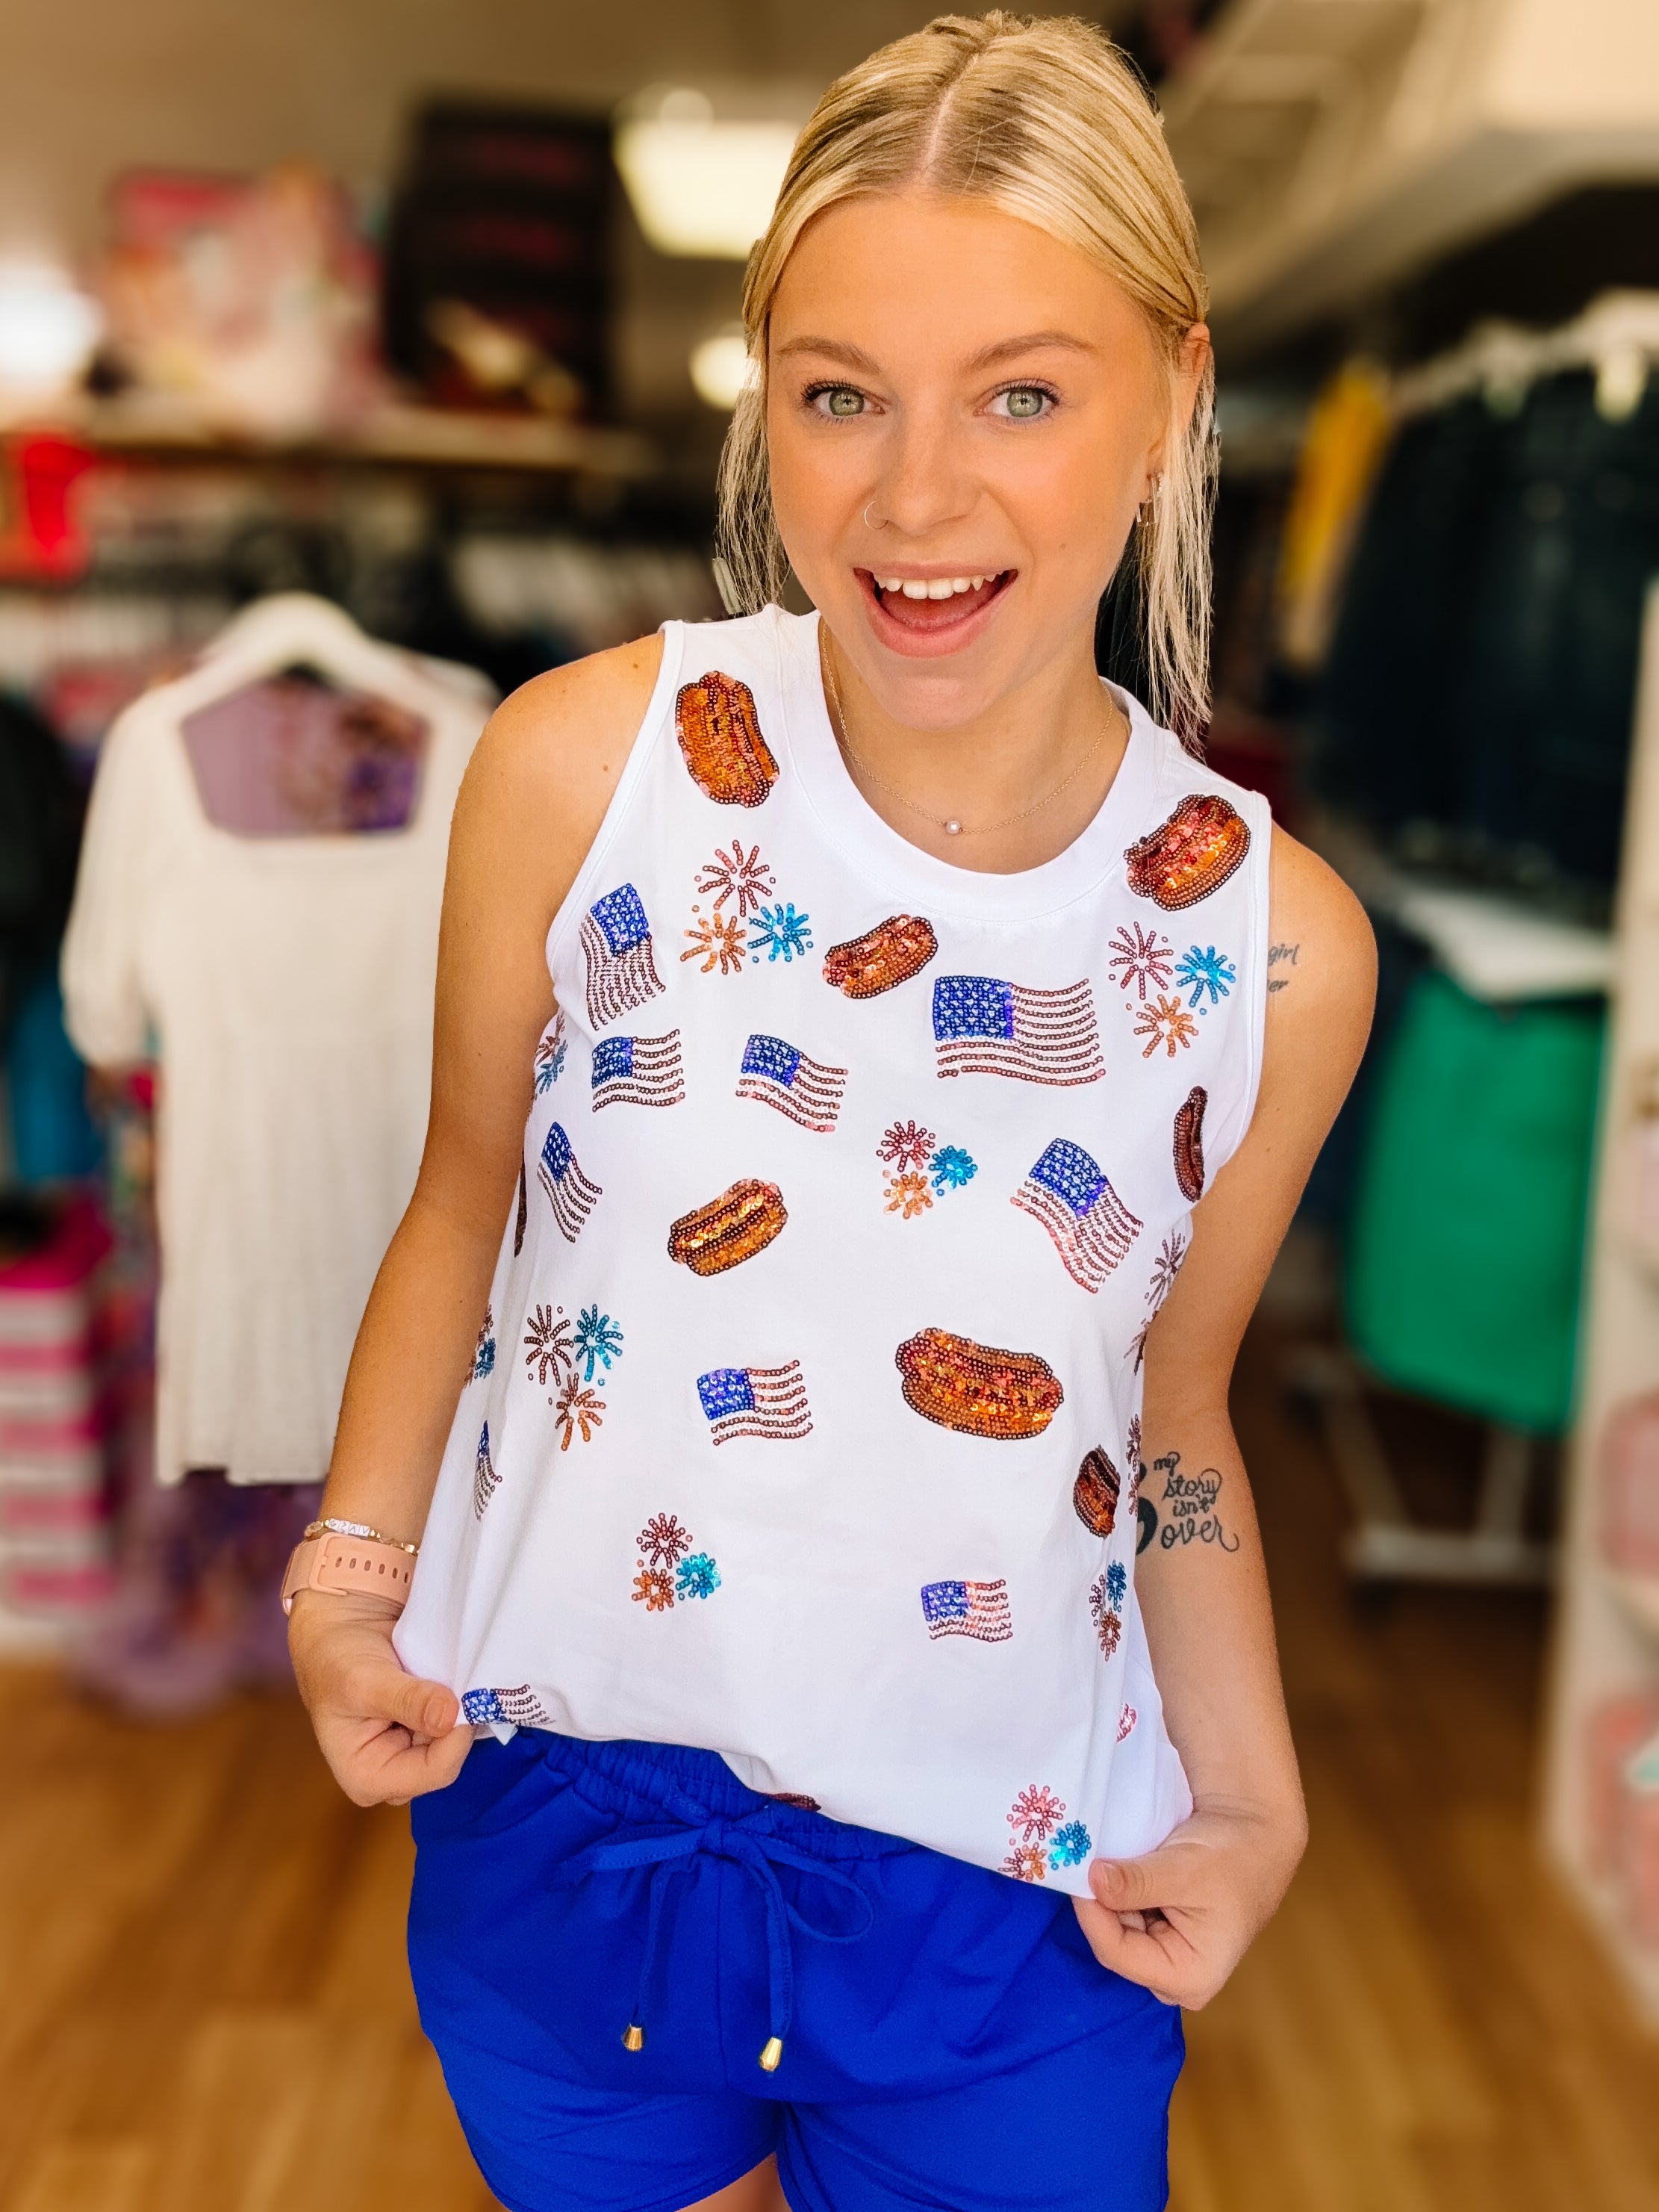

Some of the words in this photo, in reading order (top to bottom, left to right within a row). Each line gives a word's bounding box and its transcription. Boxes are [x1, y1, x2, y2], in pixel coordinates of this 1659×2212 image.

[1153, 1450, 1181, 1477] my
[1162, 1467, 1223, 1505] story
[1173, 1494, 1210, 1517] isn't
[1160, 1514, 1240, 1553] over
